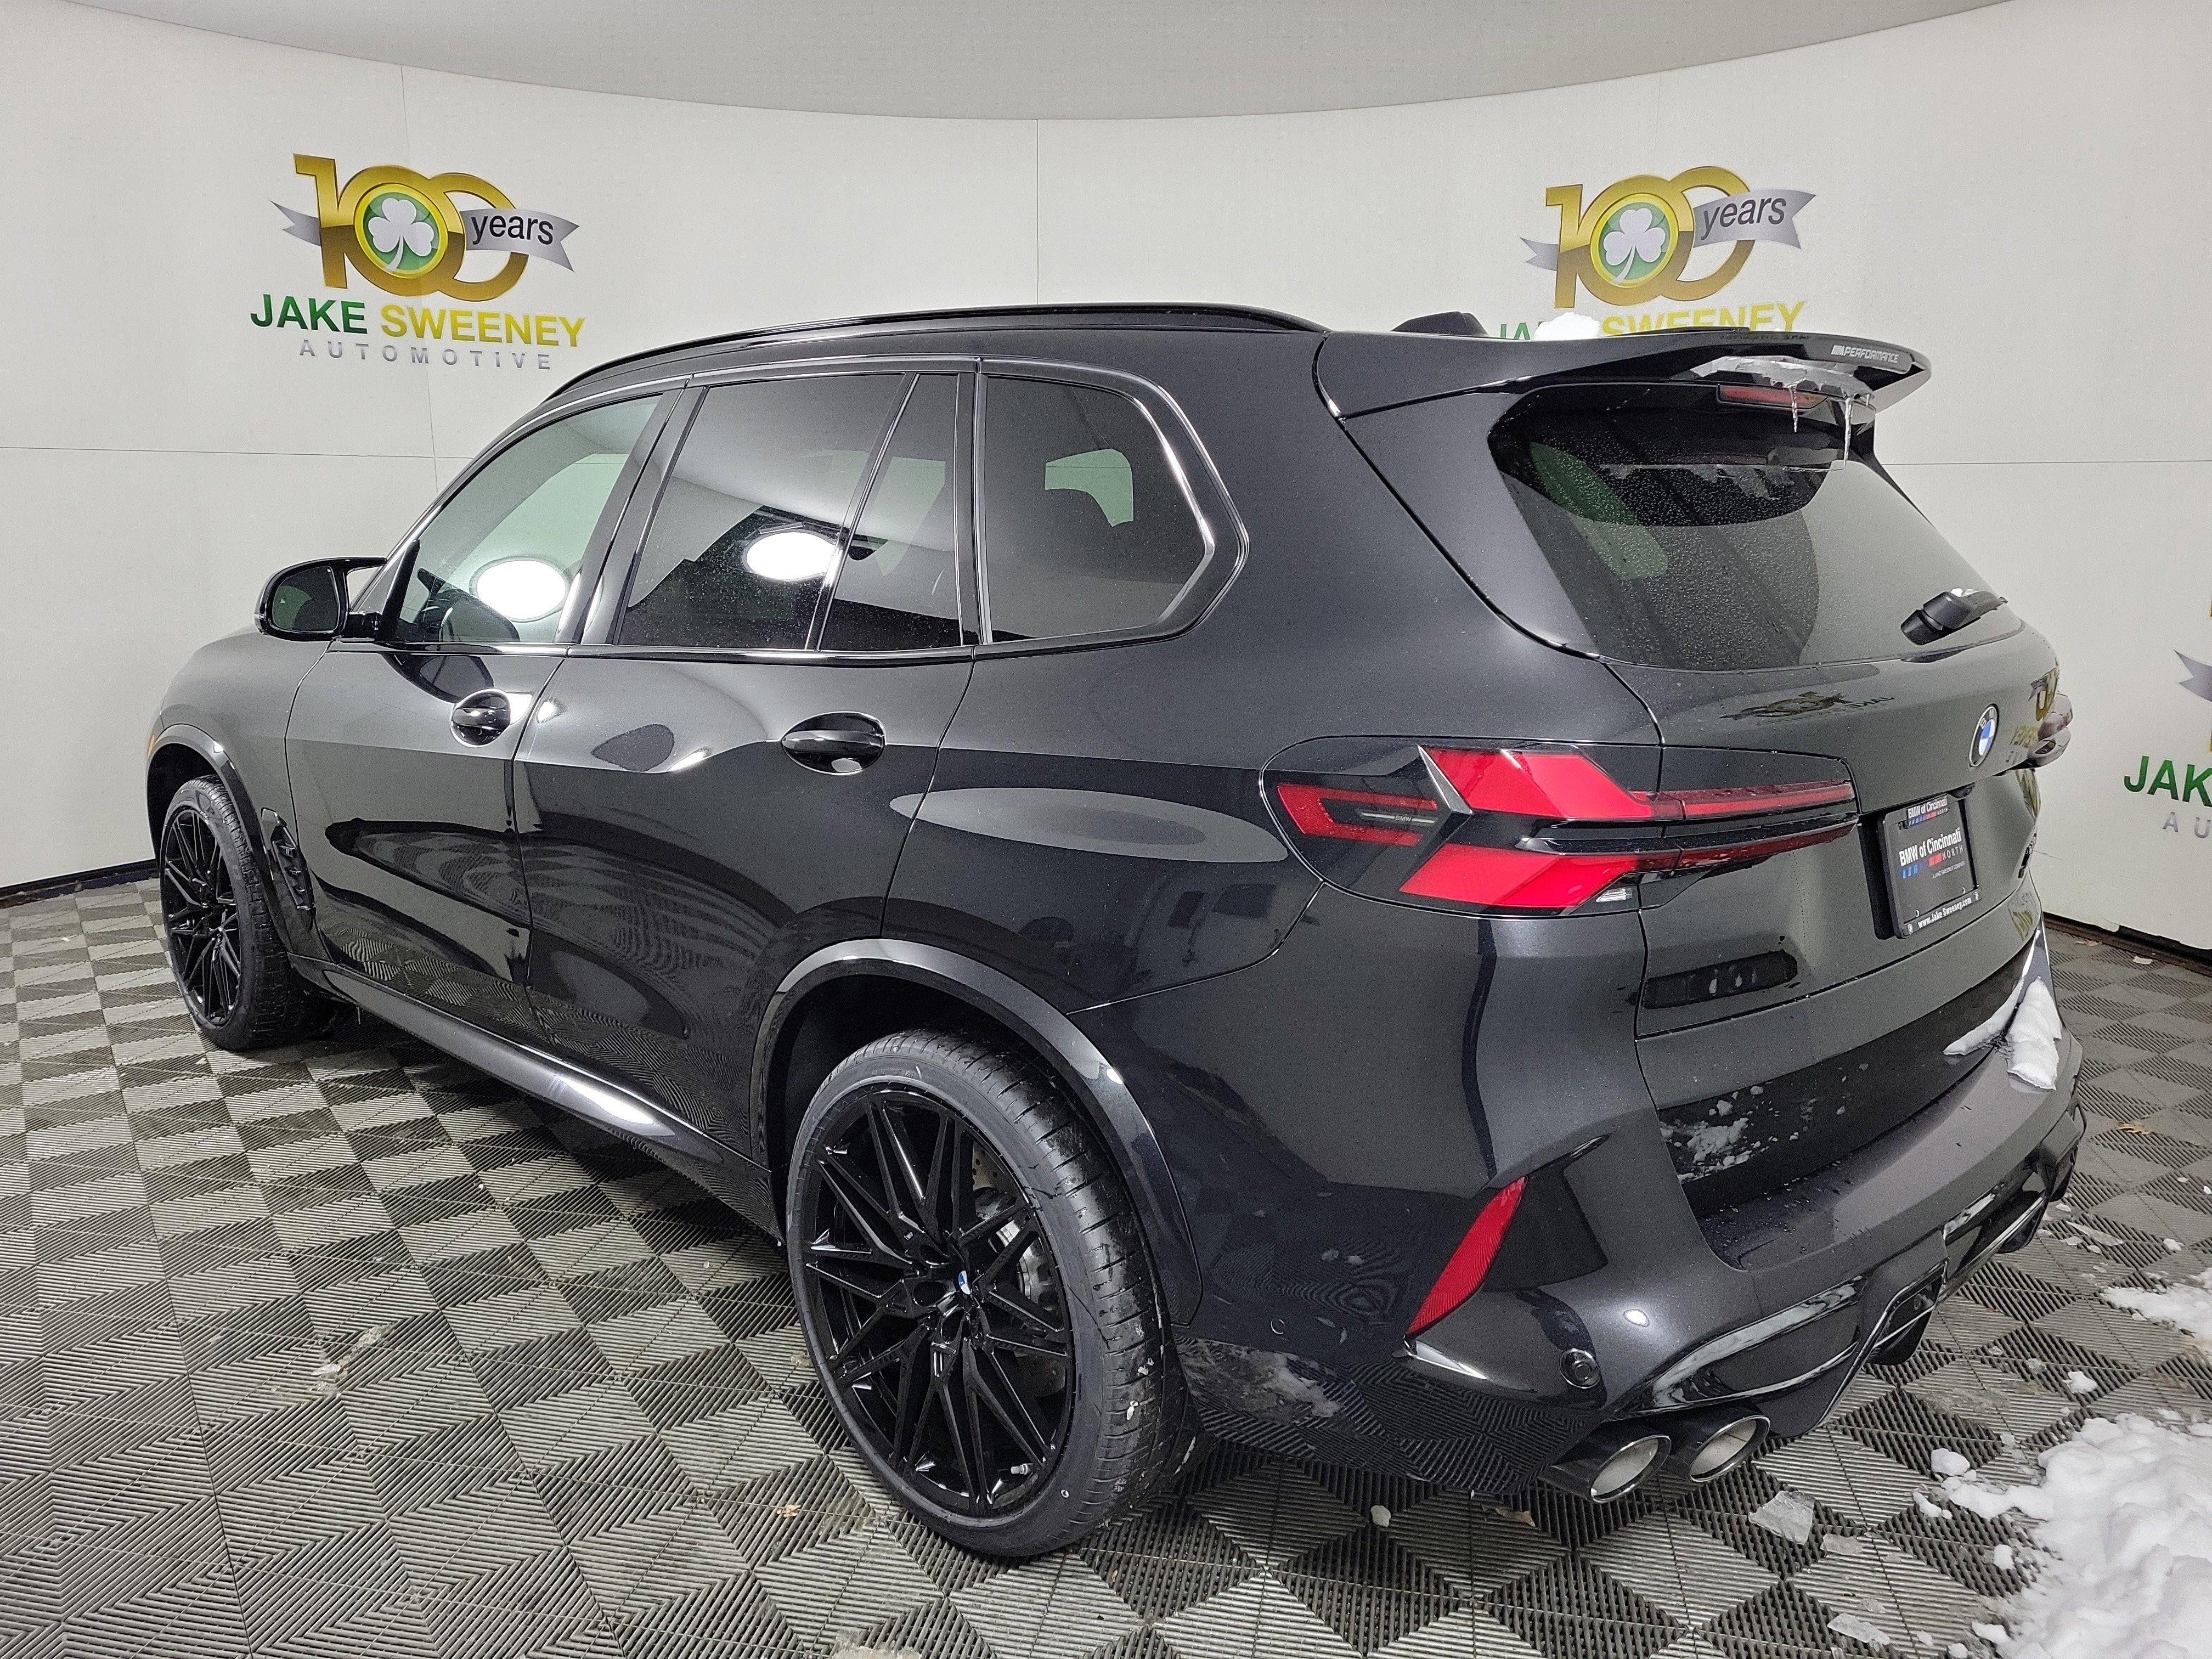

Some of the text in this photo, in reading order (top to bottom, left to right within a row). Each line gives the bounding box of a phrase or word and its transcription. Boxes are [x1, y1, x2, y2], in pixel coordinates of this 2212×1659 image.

[293, 153, 554, 302] 100 years
[1545, 166, 1786, 308] 100 years
[250, 294, 585, 347] JAKE SWEENEY
[300, 339, 550, 370] AUTOMOTIVE
[2124, 755, 2212, 808] JAK
[1908, 805, 1920, 819] BMW
[1921, 803, 1926, 814] of
[1899, 827, 1962, 867] BMW of Cincinnati
[1942, 845, 1963, 860] NORTH
